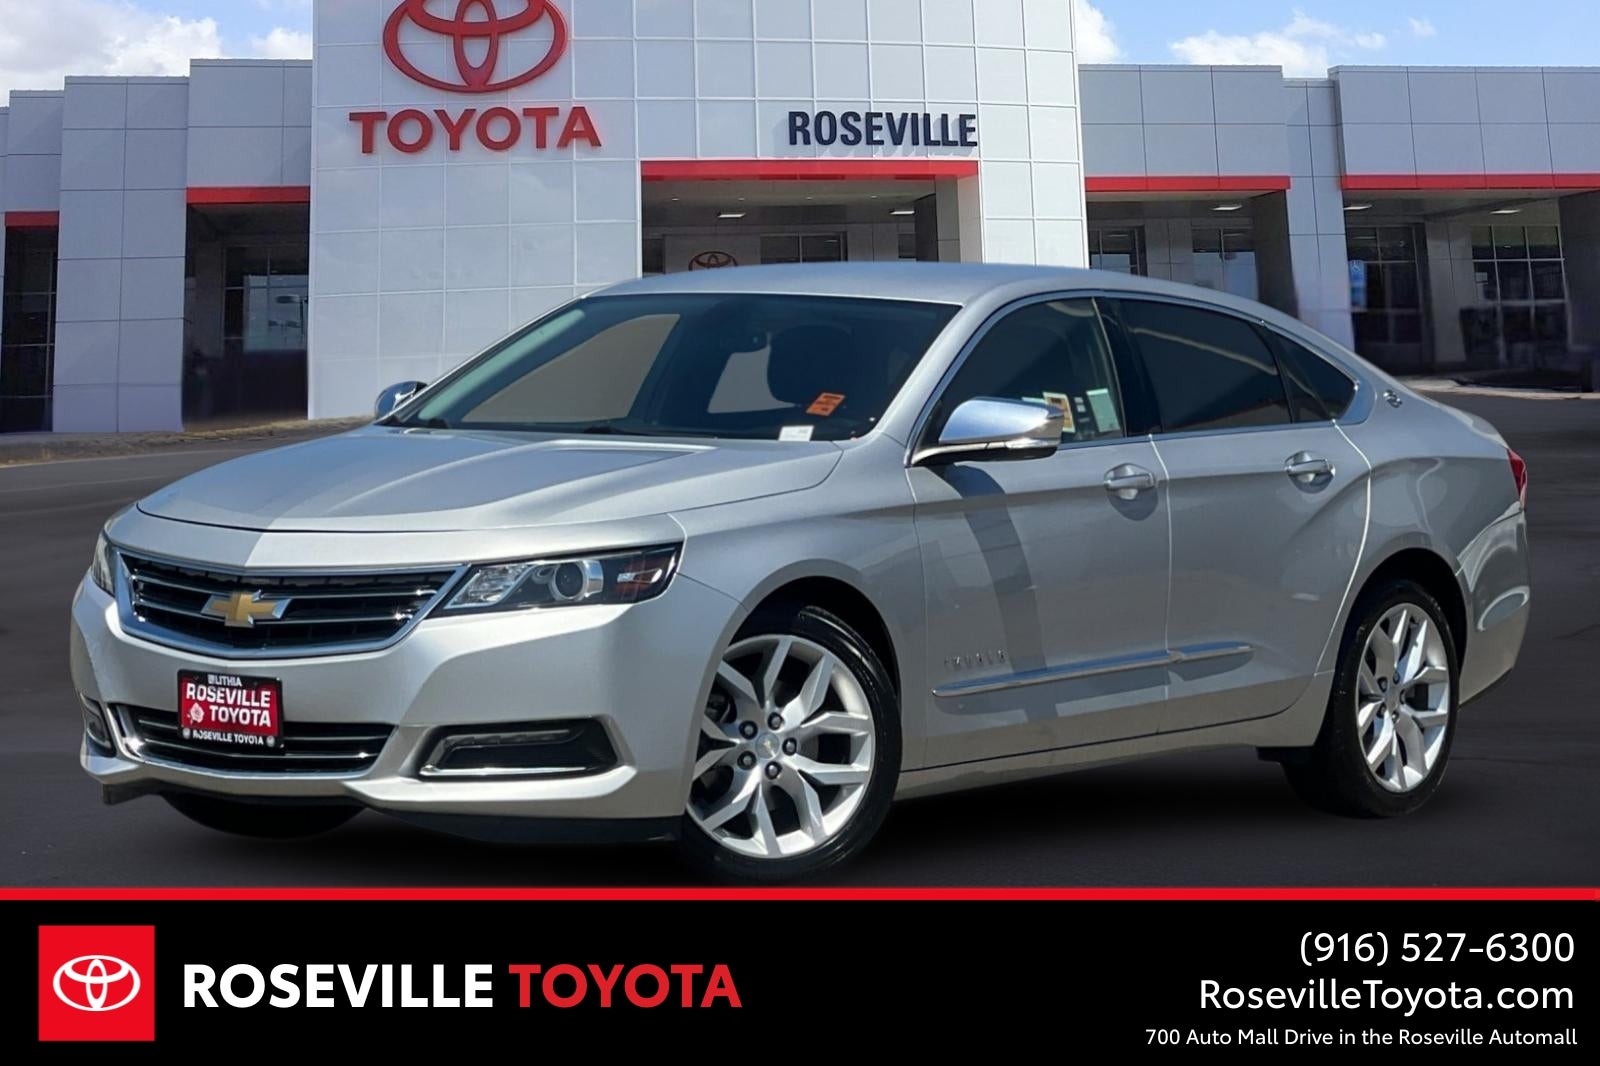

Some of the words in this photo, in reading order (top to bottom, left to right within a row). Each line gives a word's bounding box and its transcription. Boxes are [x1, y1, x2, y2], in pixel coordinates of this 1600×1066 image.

[349, 105, 602, 153] TOYOTA
[788, 110, 978, 147] ROSEVILLE
[186, 682, 271, 708] ROSEVILLE
[209, 705, 271, 727] TOYOTA
[192, 729, 233, 743] ROSEVILLE
[234, 733, 264, 745] TOYOTA
